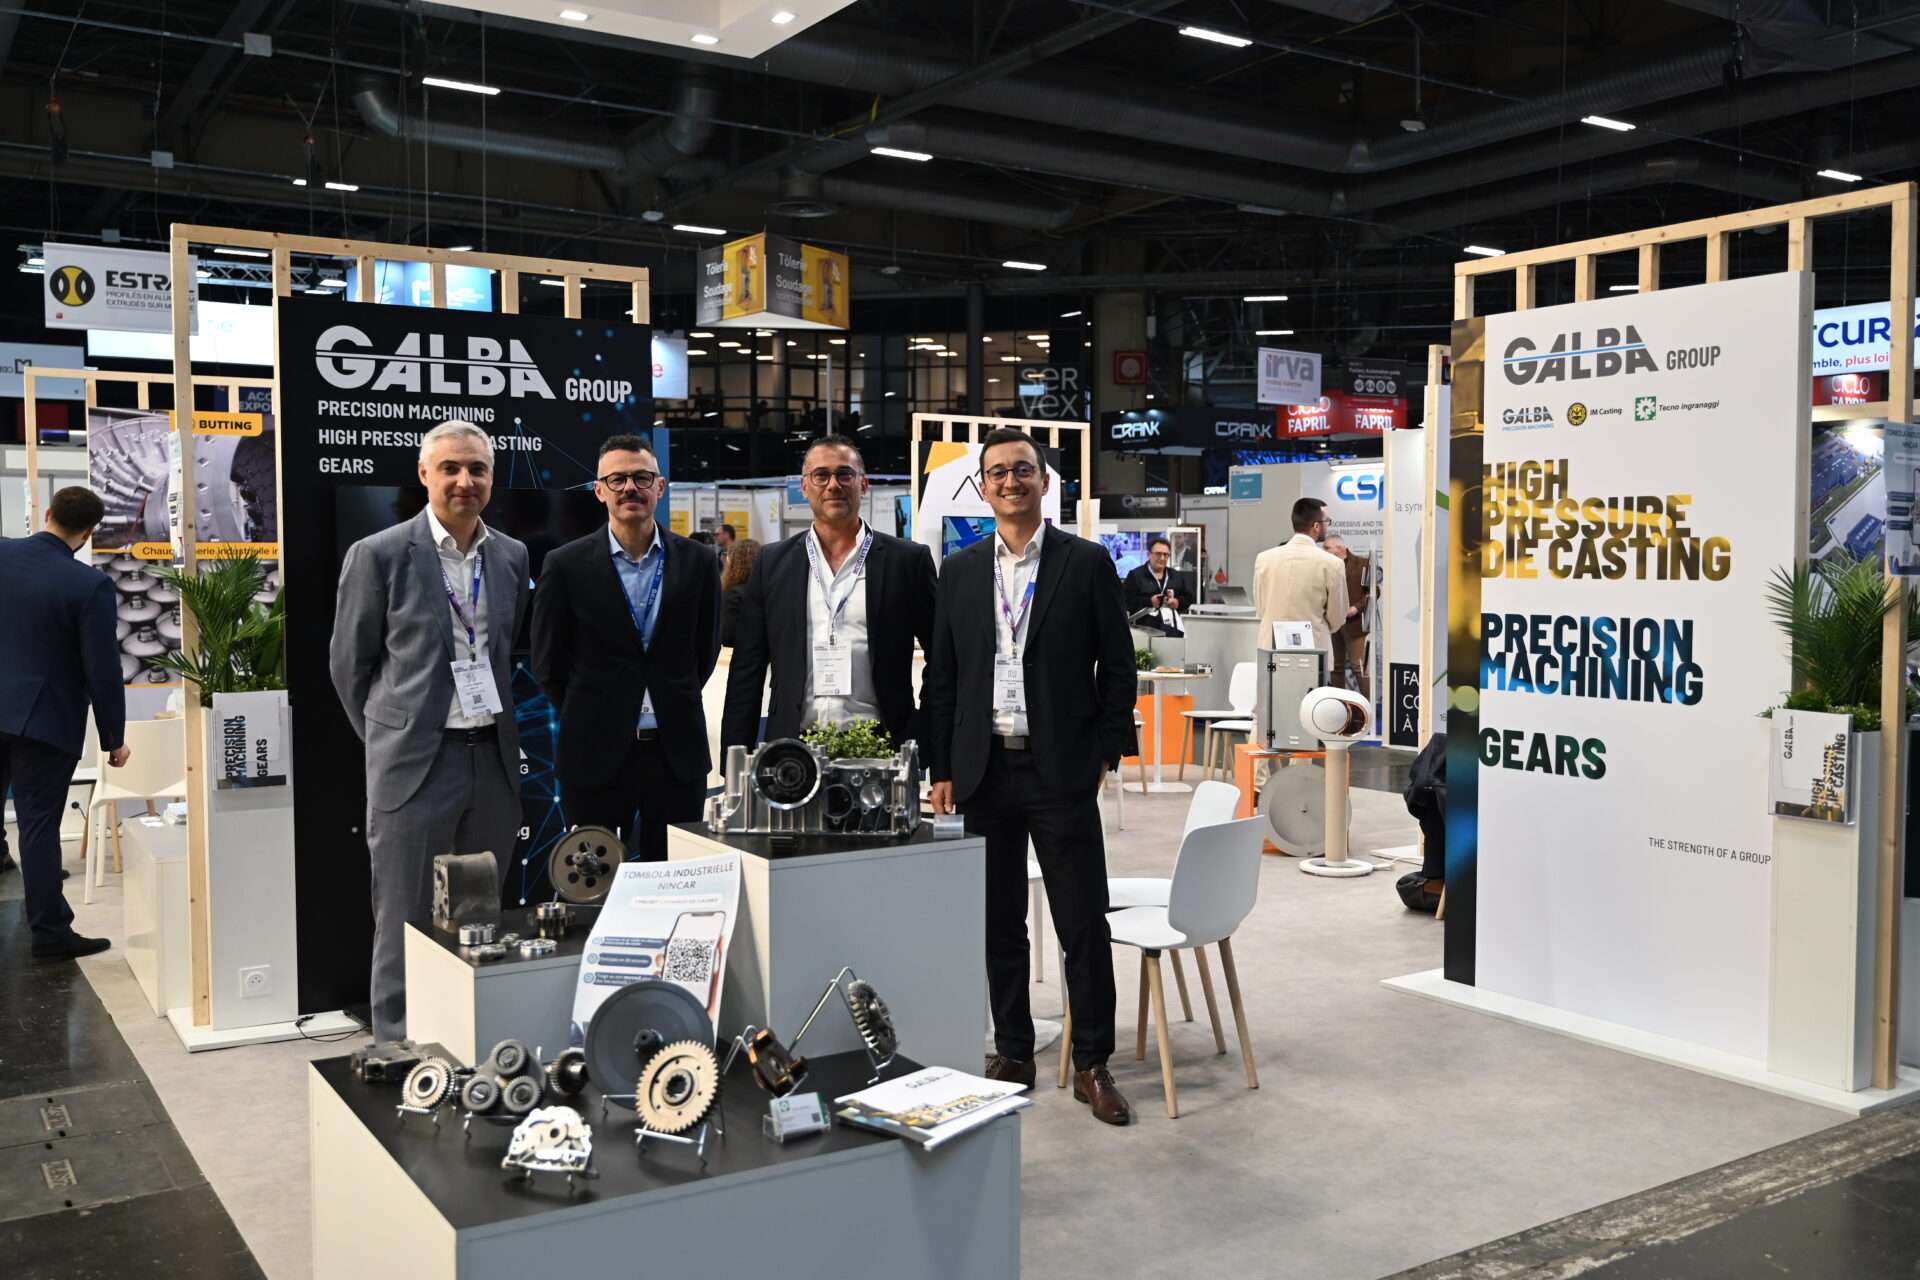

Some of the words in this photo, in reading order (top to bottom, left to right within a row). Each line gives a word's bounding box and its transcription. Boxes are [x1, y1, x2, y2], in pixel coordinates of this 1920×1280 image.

[106, 270, 194, 293] ESTR
[1813, 317, 1891, 347] CUR
[315, 325, 556, 399] GALBA
[565, 377, 632, 403] GROUP
[1265, 352, 1314, 382] irva
[1503, 325, 1658, 385] GALBA
[1666, 345, 1721, 370] GROUP
[1845, 356, 1872, 368] plus
[1874, 352, 1888, 363] loi
[318, 400, 404, 419] PRECISION
[408, 404, 496, 422] MACHINING
[1502, 406, 1554, 424] GALBA
[1599, 407, 1622, 416] Casting
[1659, 403, 1679, 412] Tecno
[1681, 400, 1720, 411] ingranaggi
[199, 420, 252, 431] BUTTING
[1112, 421, 1160, 439] CRANK
[1215, 421, 1272, 438] CRANK
[1287, 415, 1331, 433] FAPRIL
[1355, 414, 1395, 429] FAPRIL
[318, 429, 357, 445] HIGH
[362, 430, 425, 447] PRESSU
[490, 436, 542, 451] ASTING
[319, 458, 374, 474] GEARS
[1483, 458, 1568, 502] HIGH
[1483, 494, 1693, 543] PRESSURE
[1481, 538, 1538, 579] DIE
[1548, 536, 1732, 581] CASTING
[1481, 613, 1694, 662] PRECISION
[1479, 651, 1704, 706] MACHINING
[223, 718, 236, 780] PRECISION
[1479, 727, 1606, 780] GEARS
[1783, 727, 1794, 759] GALBA
[256, 738, 268, 777] GEARS
[1832, 733, 1846, 788] CASTING
[1648, 837, 1665, 849] THE
[1667, 840, 1714, 857] STRENGTH
[1716, 848, 1728, 858] OF
[1730, 849, 1737, 860] A
[1739, 851, 1772, 865] GROUP
[623, 870, 671, 880] TOMBOLA
[672, 862, 734, 878] INDUSTRIELLE
